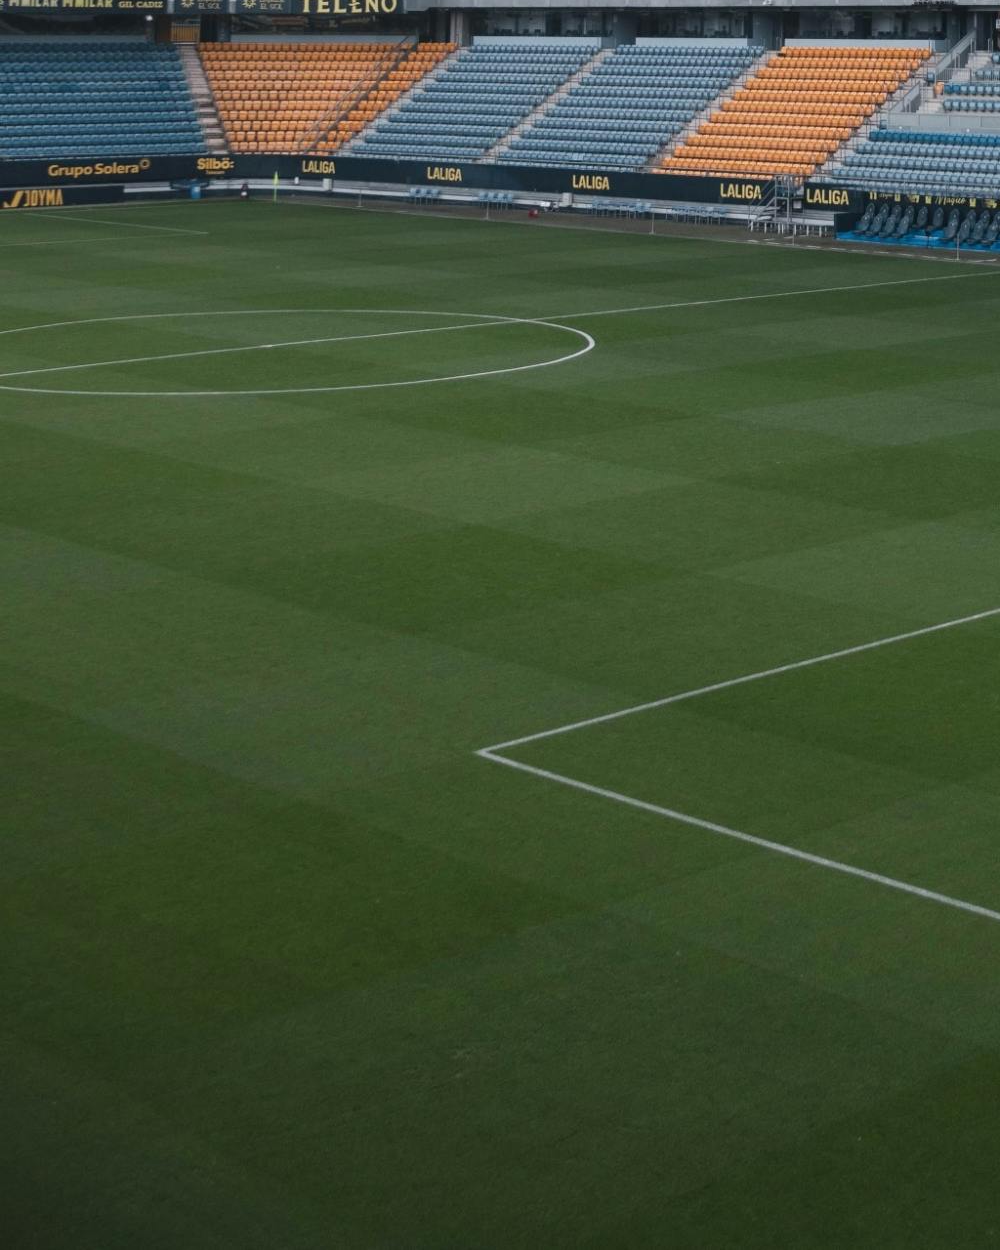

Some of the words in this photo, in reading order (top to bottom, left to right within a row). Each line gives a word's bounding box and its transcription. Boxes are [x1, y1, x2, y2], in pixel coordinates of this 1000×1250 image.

[48, 164, 93, 178] Grupo
[94, 162, 139, 175] Solera
[302, 160, 335, 174] LALIGA
[427, 166, 462, 181] LALIGA
[573, 175, 609, 190] LALIGA
[23, 189, 63, 206] JOYMA
[720, 183, 762, 199] LALIGA
[807, 188, 849, 205] LALIGA
